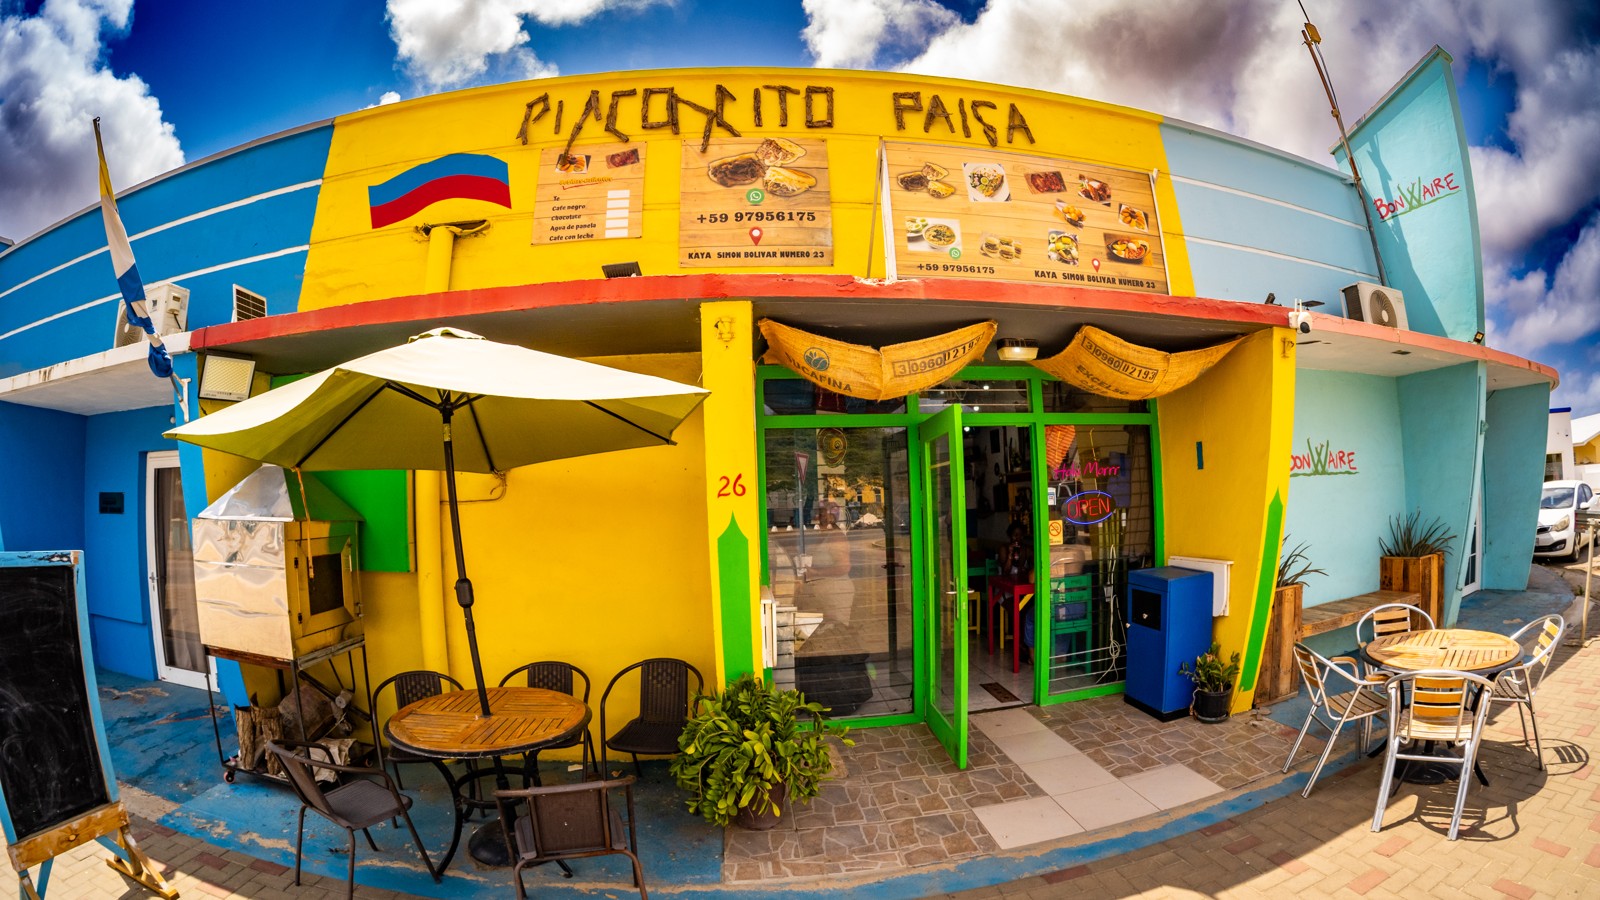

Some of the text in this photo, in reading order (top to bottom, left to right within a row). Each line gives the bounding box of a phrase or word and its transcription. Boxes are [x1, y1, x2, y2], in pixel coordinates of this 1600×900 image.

[892, 91, 1037, 148] PAISA
[575, 223, 596, 231] panela
[697, 212, 816, 224] +59 97956175
[717, 251, 741, 259] SIMON
[917, 263, 995, 274] +59 97956175
[1034, 270, 1156, 289] KAYA SIMON BOLIVAR NUMERO 23
[1076, 364, 1130, 395] EXCELSO
[717, 473, 746, 498] 26
[1067, 497, 1110, 519] OPEN
